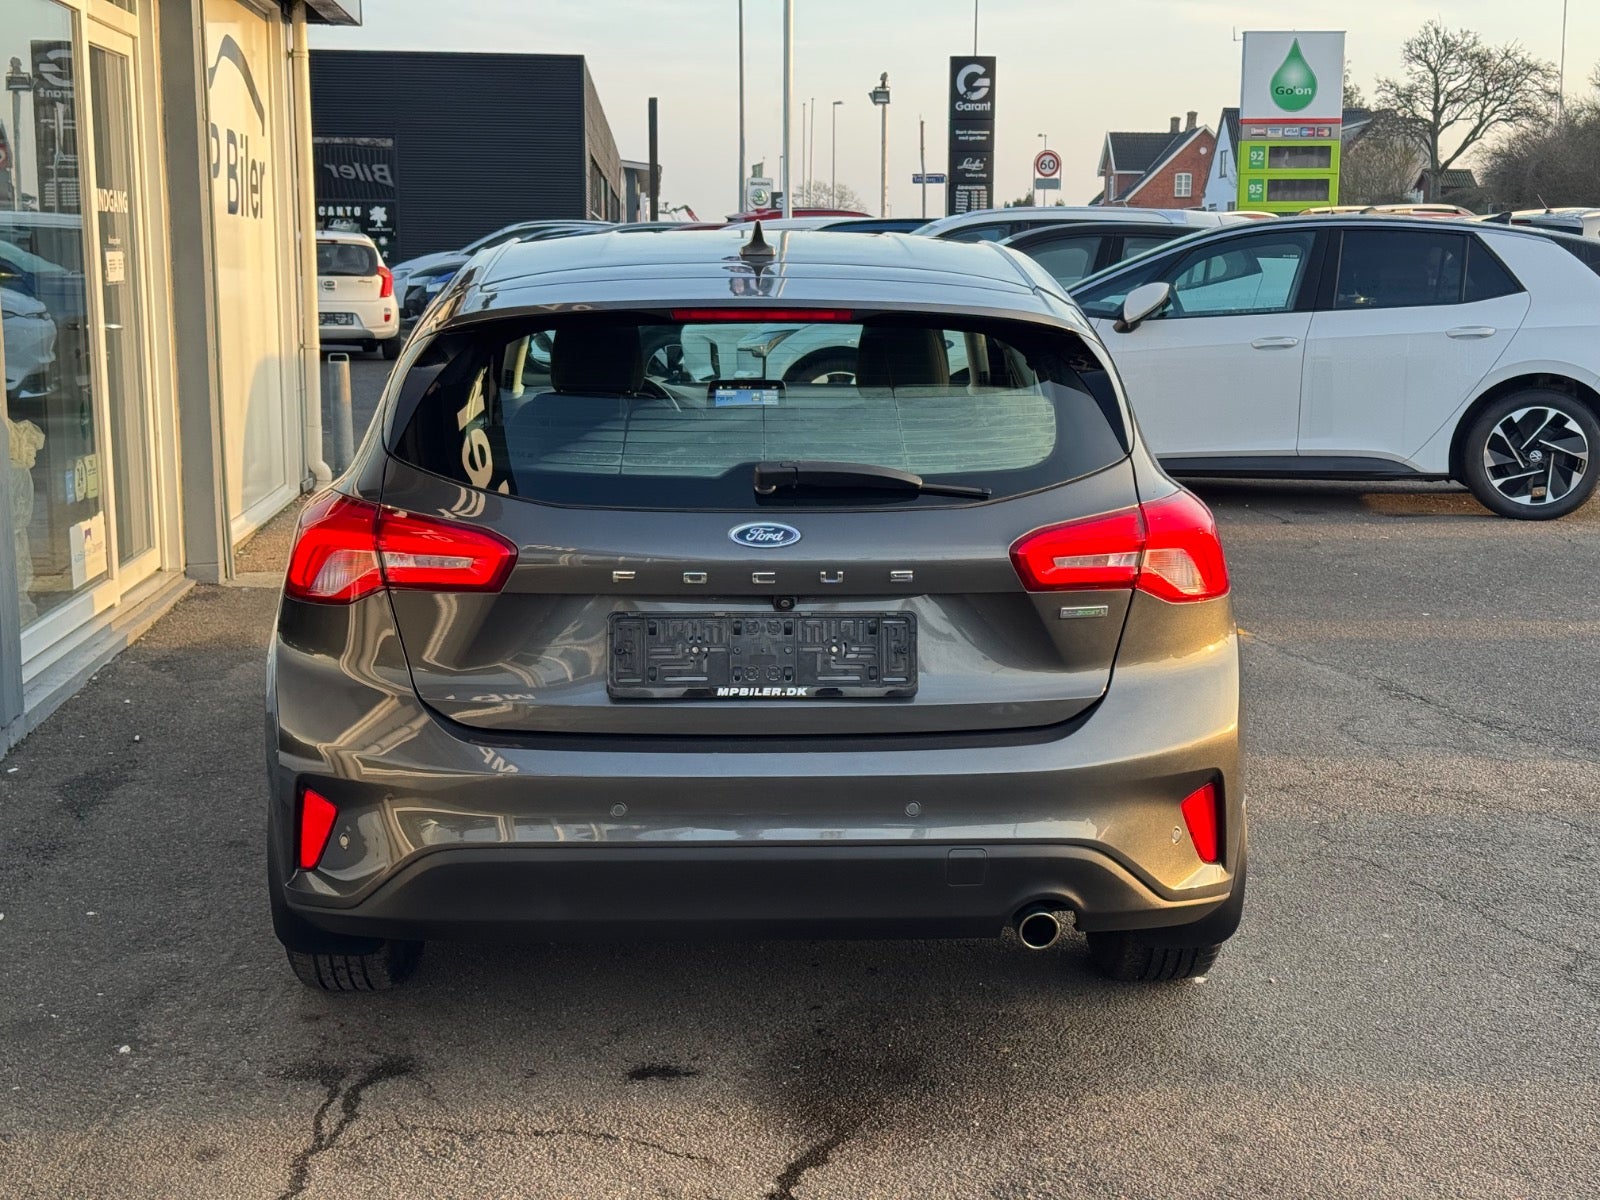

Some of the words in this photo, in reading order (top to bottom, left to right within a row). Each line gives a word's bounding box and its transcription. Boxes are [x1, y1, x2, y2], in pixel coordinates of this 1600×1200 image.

[955, 101, 991, 111] Garant
[1250, 151, 1264, 161] 92
[1040, 159, 1056, 170] 60
[227, 128, 265, 219] Biler
[1248, 184, 1263, 194] 95
[745, 527, 784, 542] Ford
[612, 570, 914, 584] FOCUS
[716, 687, 808, 697] MPBILER.DK
